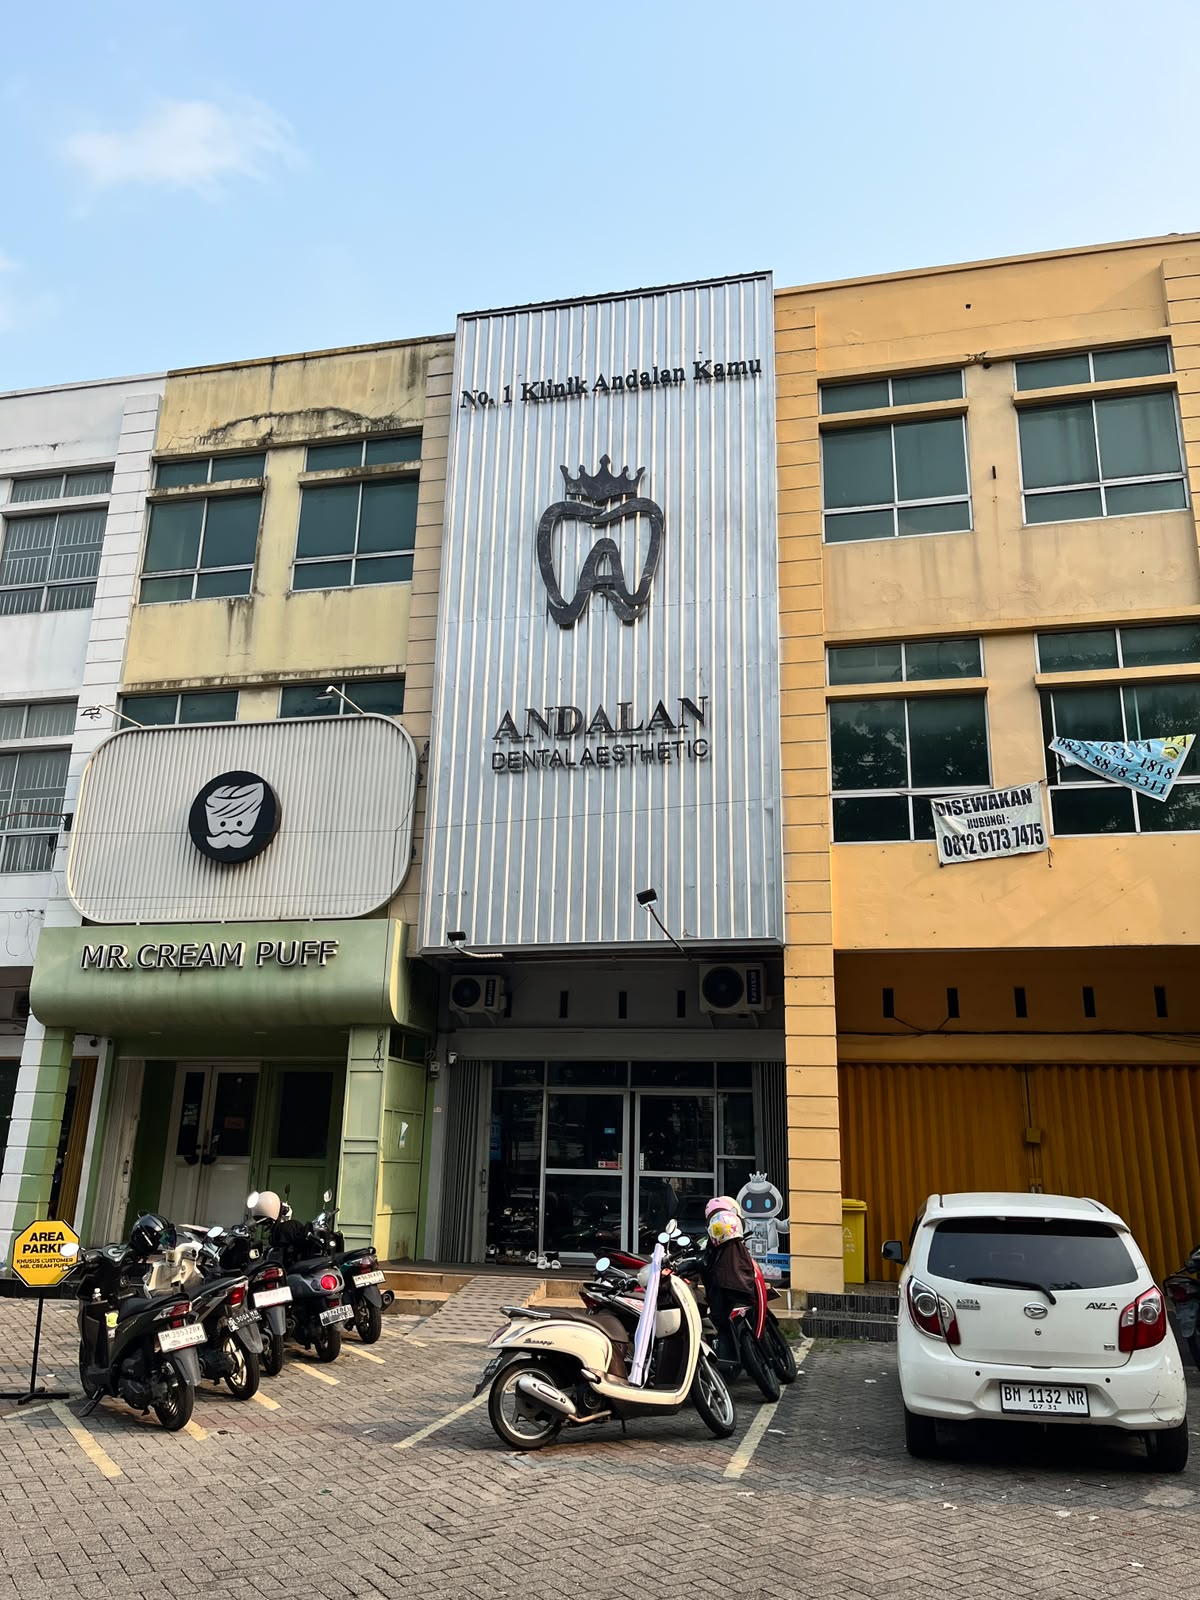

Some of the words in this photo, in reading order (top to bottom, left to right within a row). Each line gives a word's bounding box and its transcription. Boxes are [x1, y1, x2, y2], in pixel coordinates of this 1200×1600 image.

[460, 389, 495, 408] No.
[503, 384, 512, 403] 1
[520, 376, 588, 402] Klinik
[592, 365, 686, 392] Andalan
[692, 358, 762, 380] Kamu
[492, 695, 709, 741] ANDALAN
[492, 748, 577, 771] DENTAL
[579, 738, 709, 767] AESTHETIC
[1057, 737, 1090, 760] 0823
[1092, 755, 1129, 778] 8878
[1130, 772, 1166, 795] 3311
[1100, 742, 1135, 763] 6532
[1140, 757, 1175, 780] 1818
[935, 788, 1033, 817] DISEWAKAN
[943, 833, 978, 857] 0812
[978, 828, 1012, 853] 6173
[1012, 823, 1044, 848] 7475
[80, 944, 133, 969] MR.
[136, 942, 246, 969] CREAM
[255, 940, 340, 968] PUFF
[22, 1243, 67, 1254] PARKI
[30, 1232, 65, 1242] AREA
[1004, 1386, 1021, 1402] BM
[1028, 1388, 1062, 1404] 1132
[1068, 1389, 1085, 1406] NR
